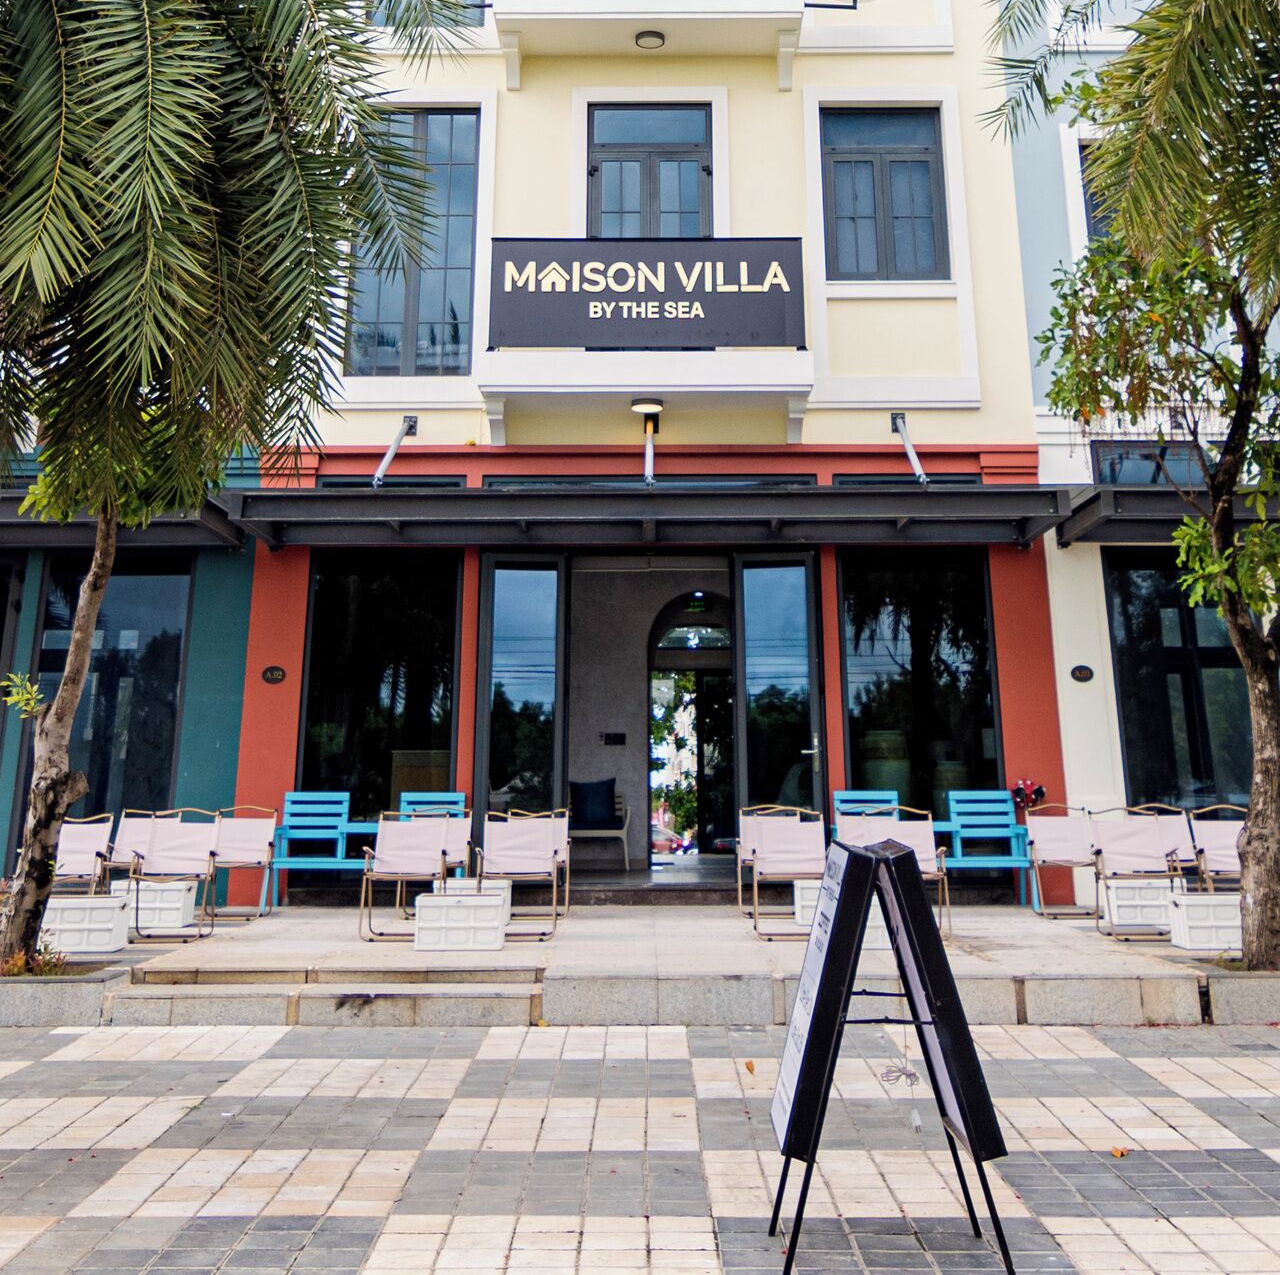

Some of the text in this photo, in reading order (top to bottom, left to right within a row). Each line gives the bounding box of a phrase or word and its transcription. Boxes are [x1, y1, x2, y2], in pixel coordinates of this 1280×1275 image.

[504, 261, 791, 293] MAISON VILLA
[589, 301, 705, 319] BY THE SEA
